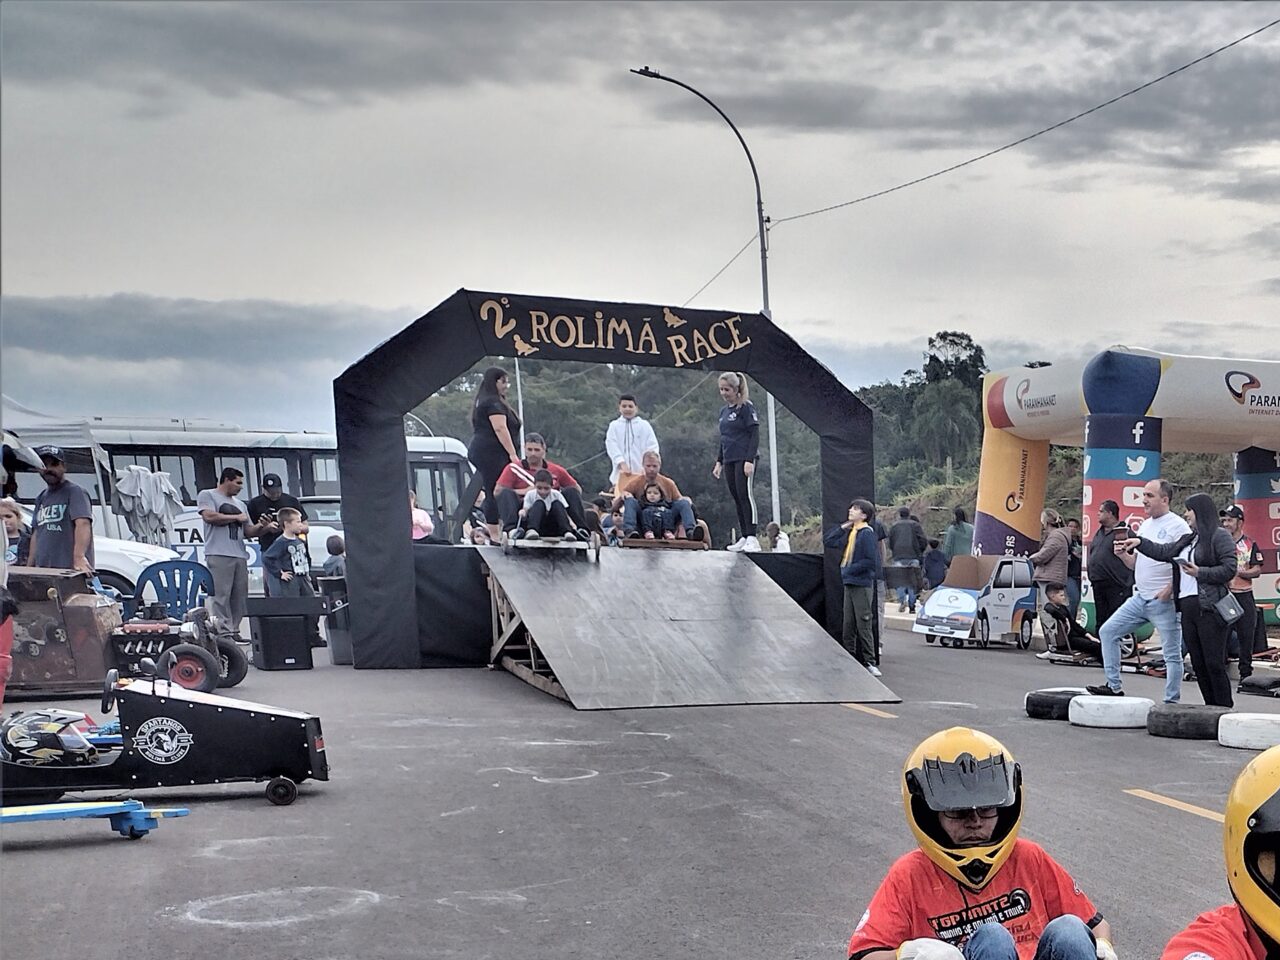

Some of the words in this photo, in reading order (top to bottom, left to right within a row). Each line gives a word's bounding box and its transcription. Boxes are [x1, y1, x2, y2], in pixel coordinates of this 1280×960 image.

[667, 315, 751, 367] RACE
[47, 524, 62, 532] USA
[141, 719, 182, 733] SPARTANOS
